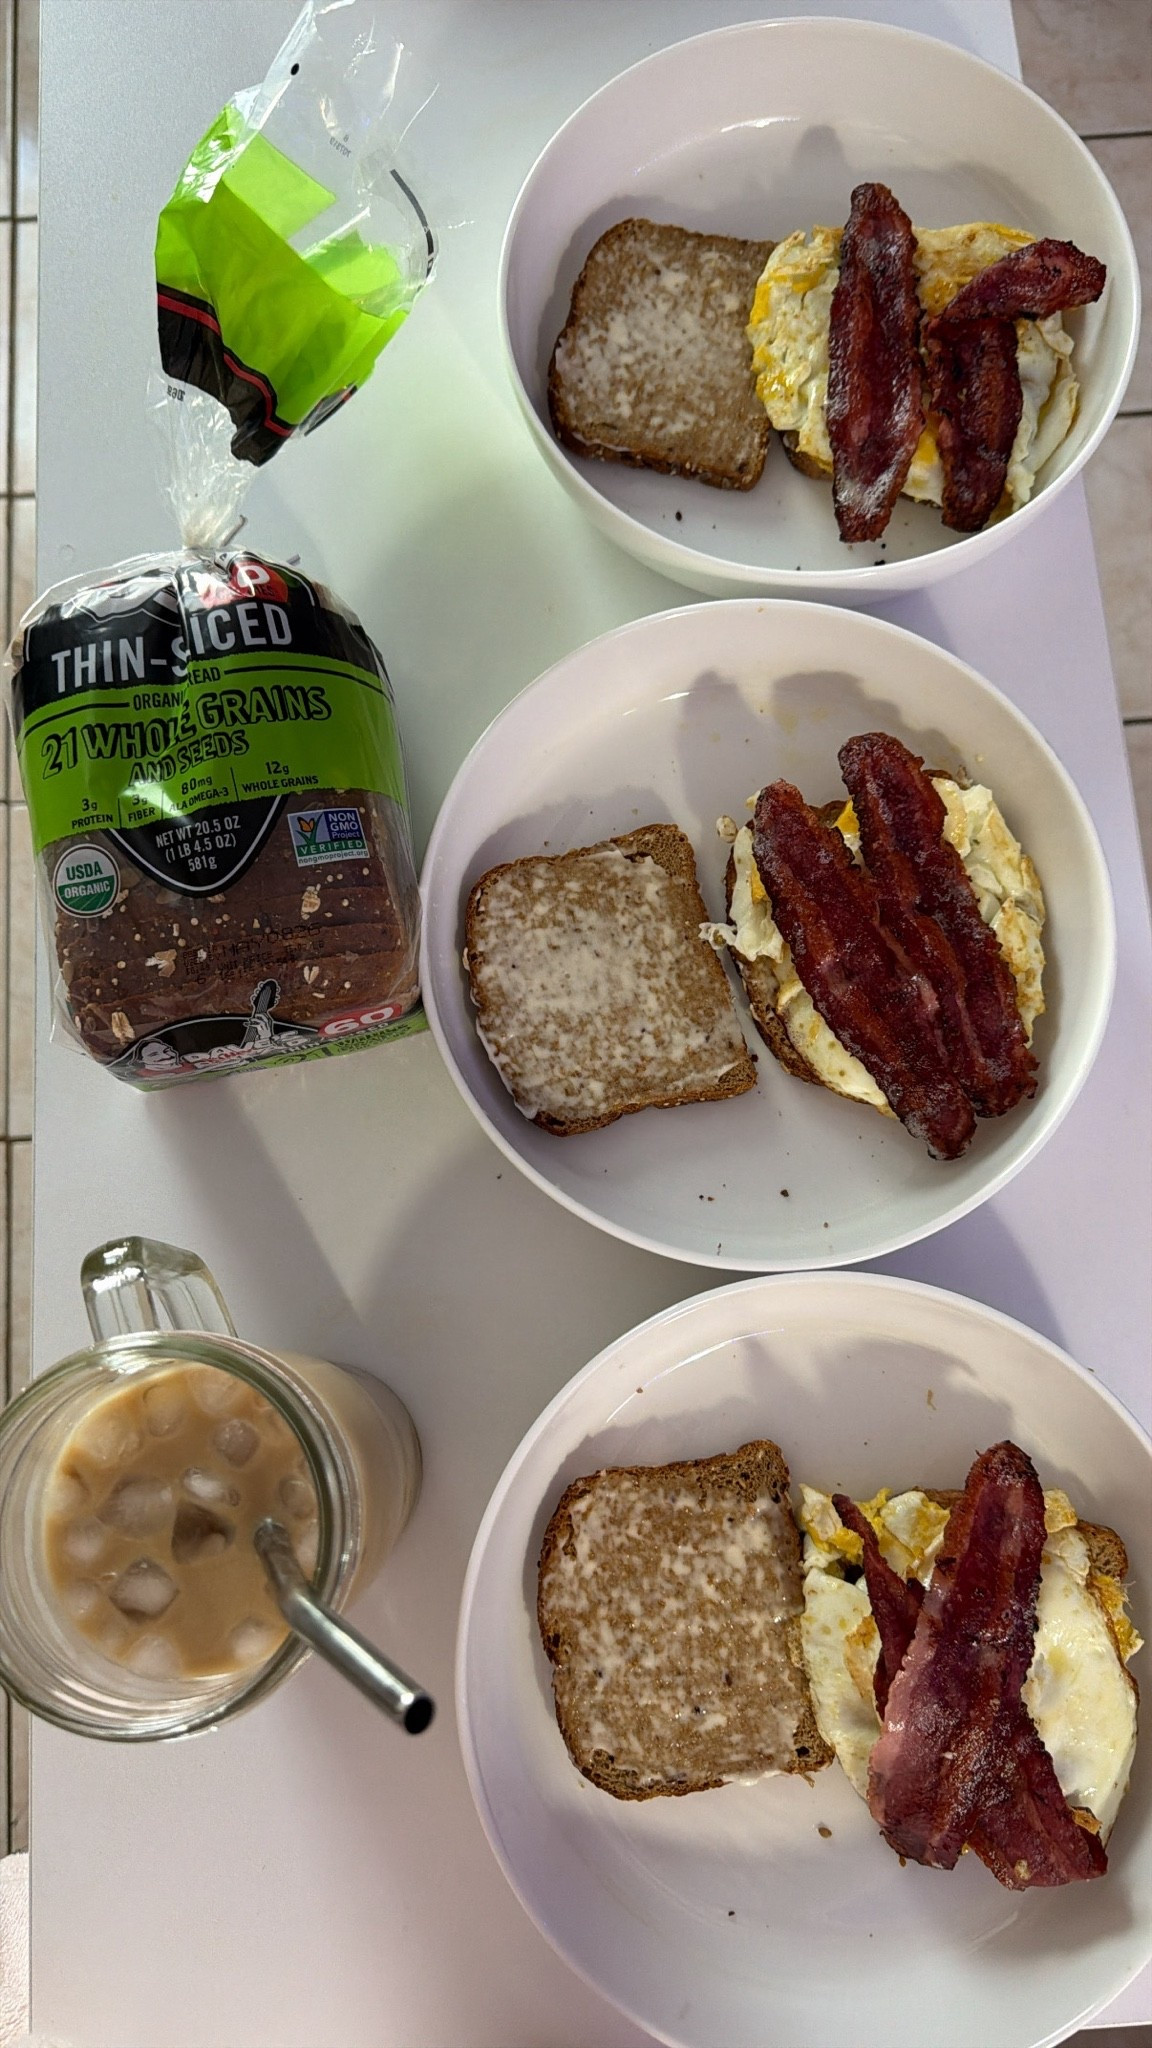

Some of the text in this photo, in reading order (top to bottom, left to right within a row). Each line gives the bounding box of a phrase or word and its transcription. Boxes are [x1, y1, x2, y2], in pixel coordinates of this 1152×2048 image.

[51, 602, 292, 693] THIN-SICED
[187, 667, 221, 685] READ
[42, 726, 77, 780] 21
[197, 686, 332, 730] GRAINS
[129, 730, 249, 788] AND SEEDS
[266, 761, 290, 775] 12g
[181, 776, 212, 795] 80mg
[242, 775, 319, 793] WHOLE GRAINS
[82, 799, 97, 812] 3g
[131, 793, 148, 807] 3g
[169, 787, 229, 813] ALA OMEGA-3
[71, 813, 113, 830] PROTEIN
[128, 807, 156, 823] FIBER
[328, 812, 356, 822] NON
[156, 815, 241, 848] NET WT 20.5 OZ
[330, 821, 358, 831] GMO
[332, 831, 360, 839] Project
[177, 842, 192, 857] LB
[193, 838, 212, 854] 4.5
[214, 834, 237, 849] OZ)
[300, 840, 363, 855] VERIFIED
[188, 855, 218, 872] 581g
[298, 850, 369, 864] nongmoproject.org
[66, 861, 103, 881] USDA
[64, 881, 111, 899] ORGANIC
[324, 1007, 394, 1034] 60
